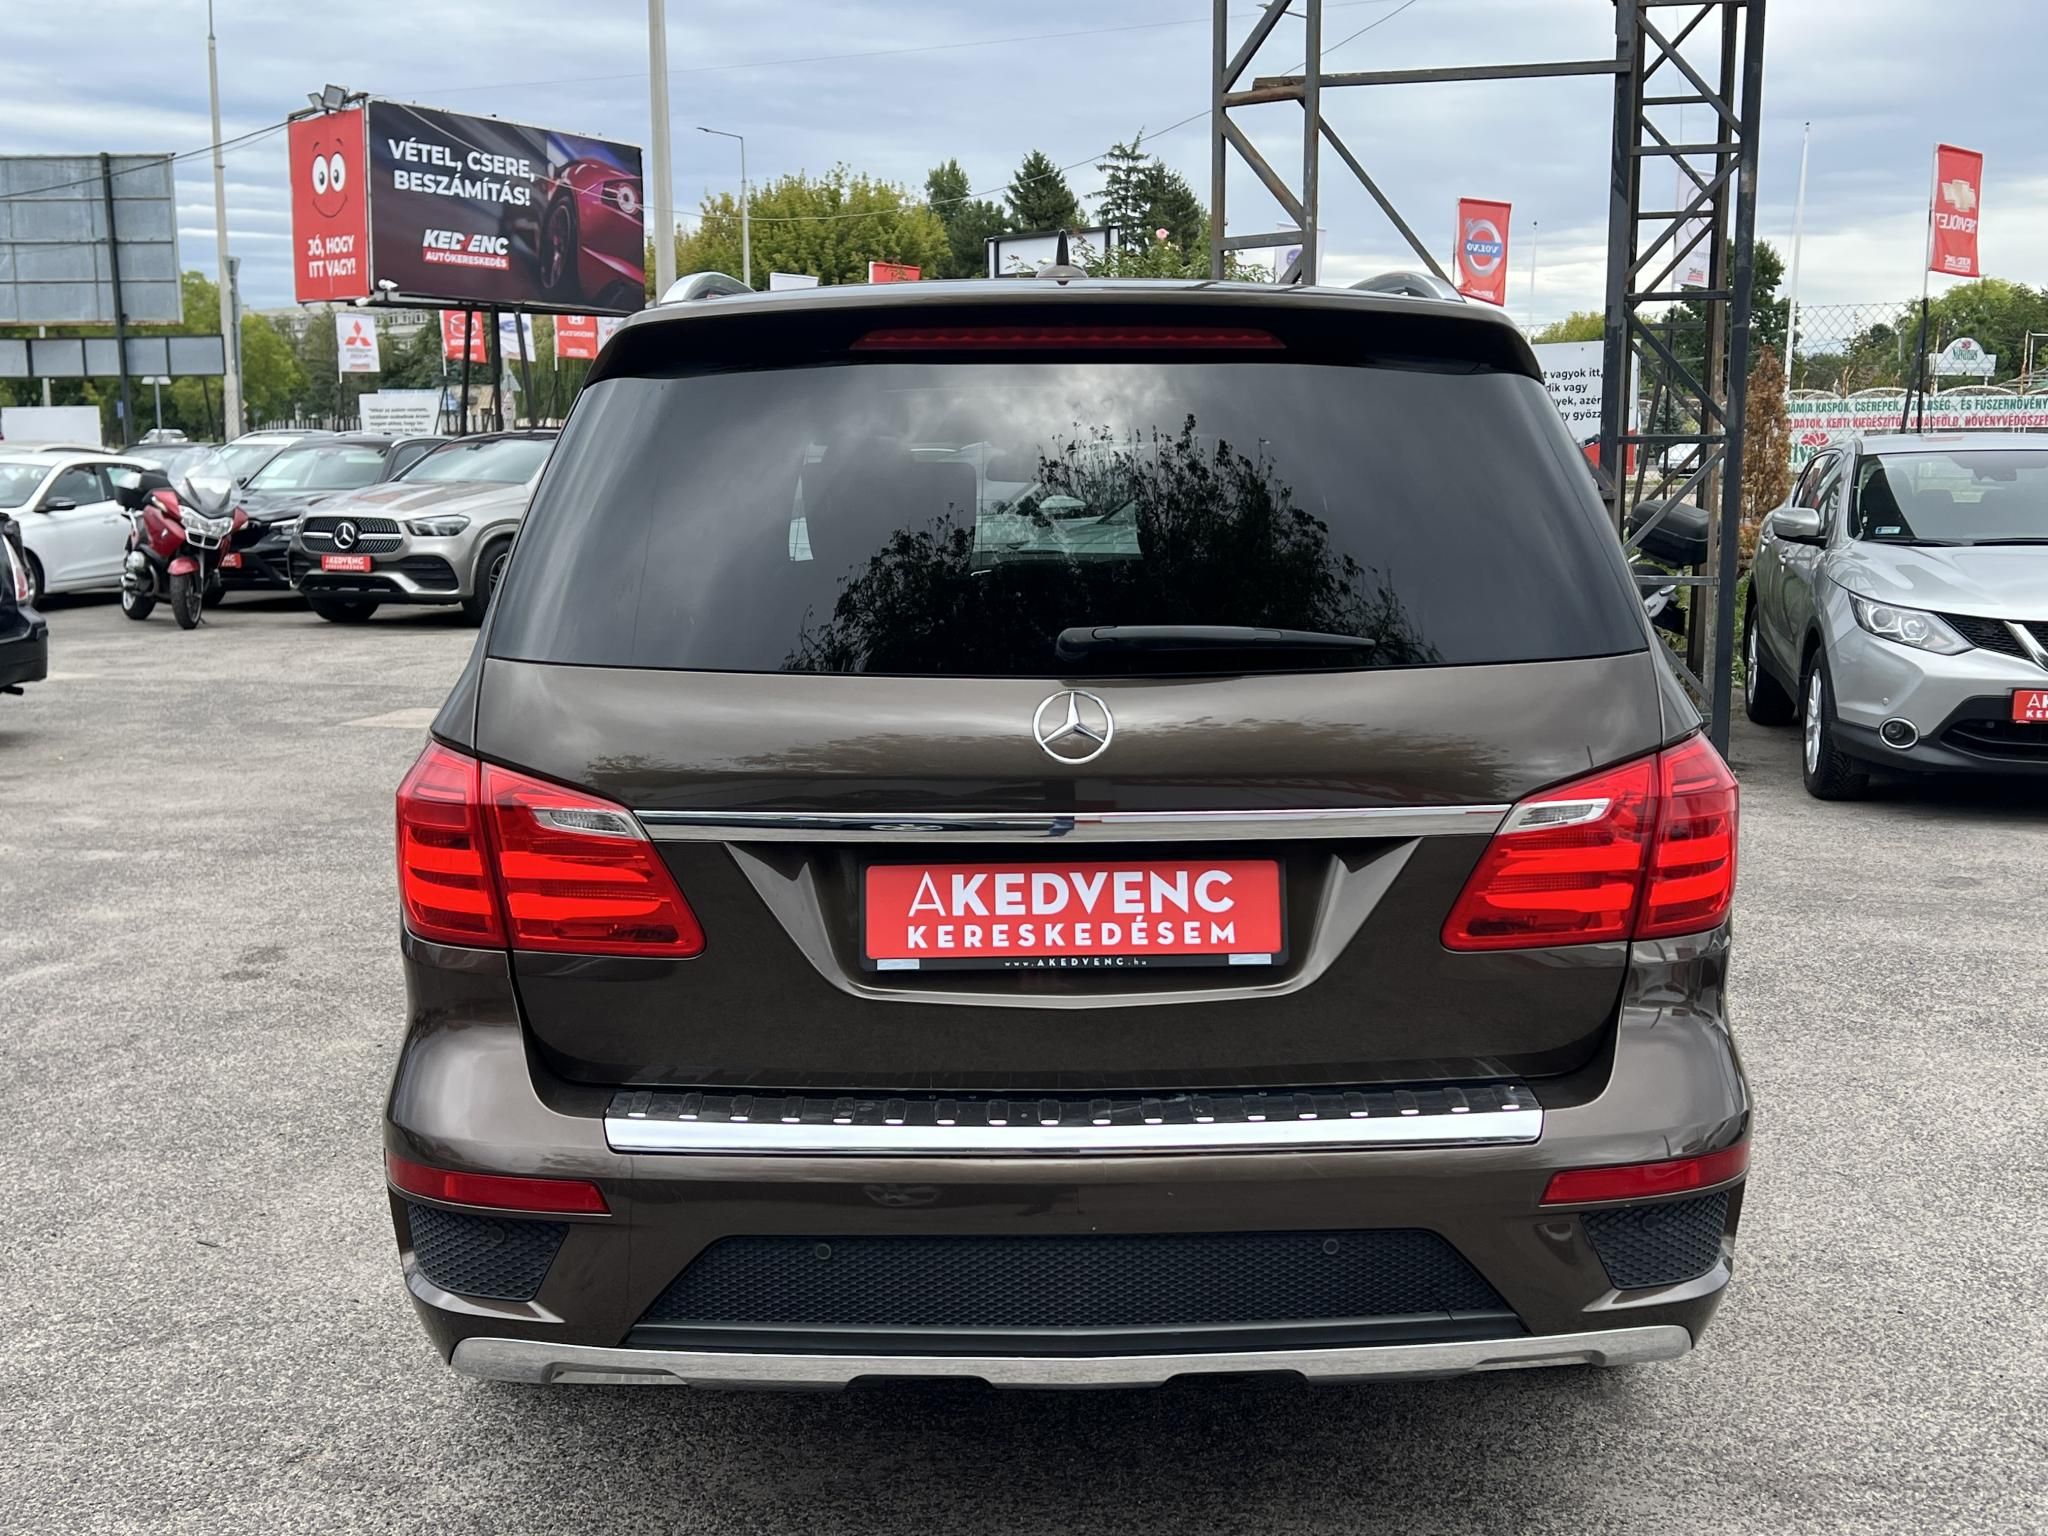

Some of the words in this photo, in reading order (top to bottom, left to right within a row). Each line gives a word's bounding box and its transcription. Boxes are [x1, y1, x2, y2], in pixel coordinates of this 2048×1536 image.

[388, 137, 462, 171] VÉTEL,
[467, 151, 535, 182] CSERE,
[393, 170, 531, 206] BESZÁMÍTÁS!
[307, 233, 325, 258] JÓ,
[326, 234, 354, 254] HOGY
[309, 260, 324, 278] ITT
[325, 257, 356, 277] VAGY!
[425, 250, 507, 268] AUTÓKERESKEDÉS
[1550, 368, 1586, 380] vagyok
[1563, 384, 1588, 393] vagy
[1579, 395, 1601, 403] azér
[1961, 398, 1972, 410] ÉS
[908, 870, 1235, 917] AKEDVENC
[907, 915, 1235, 948] KERESKEDÉSEM
[1004, 957, 1147, 967] www.AKEDVENC.hu
